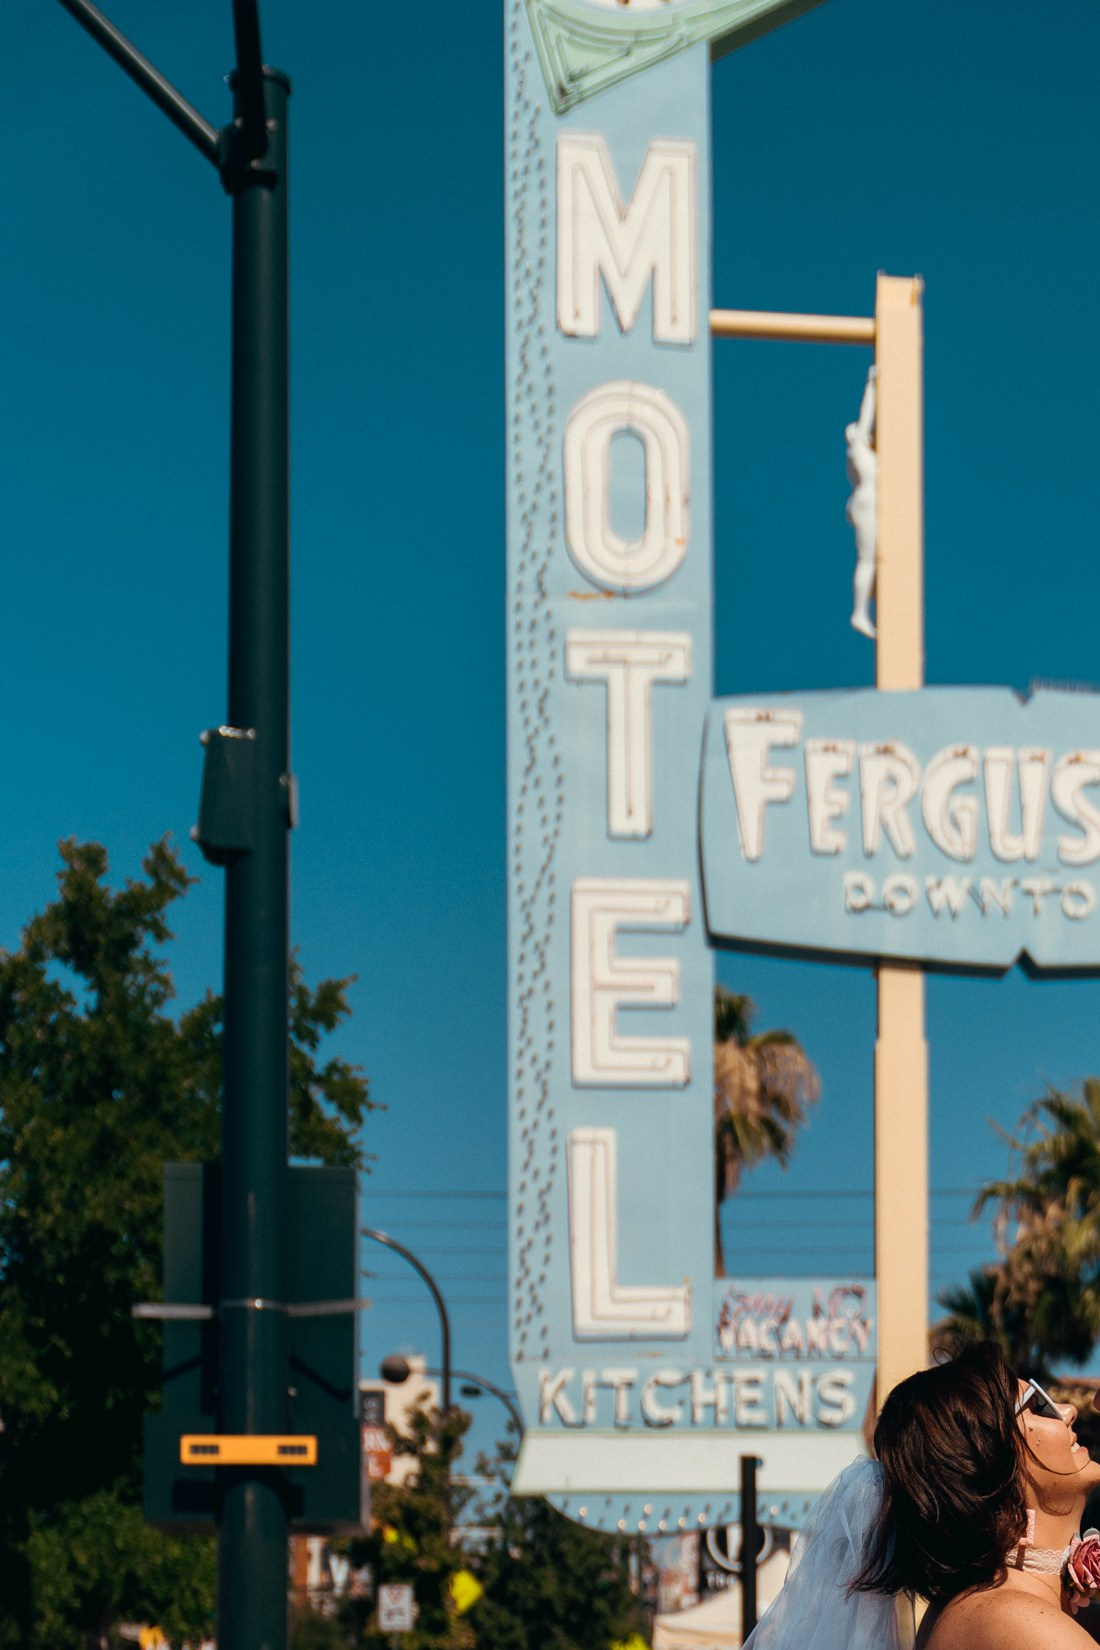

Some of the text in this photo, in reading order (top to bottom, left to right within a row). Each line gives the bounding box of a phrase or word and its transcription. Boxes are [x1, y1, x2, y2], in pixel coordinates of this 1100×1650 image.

[556, 130, 697, 1341] MOTEL
[717, 1317, 874, 1359] VACANCY
[538, 1369, 857, 1428] KITCHENS
